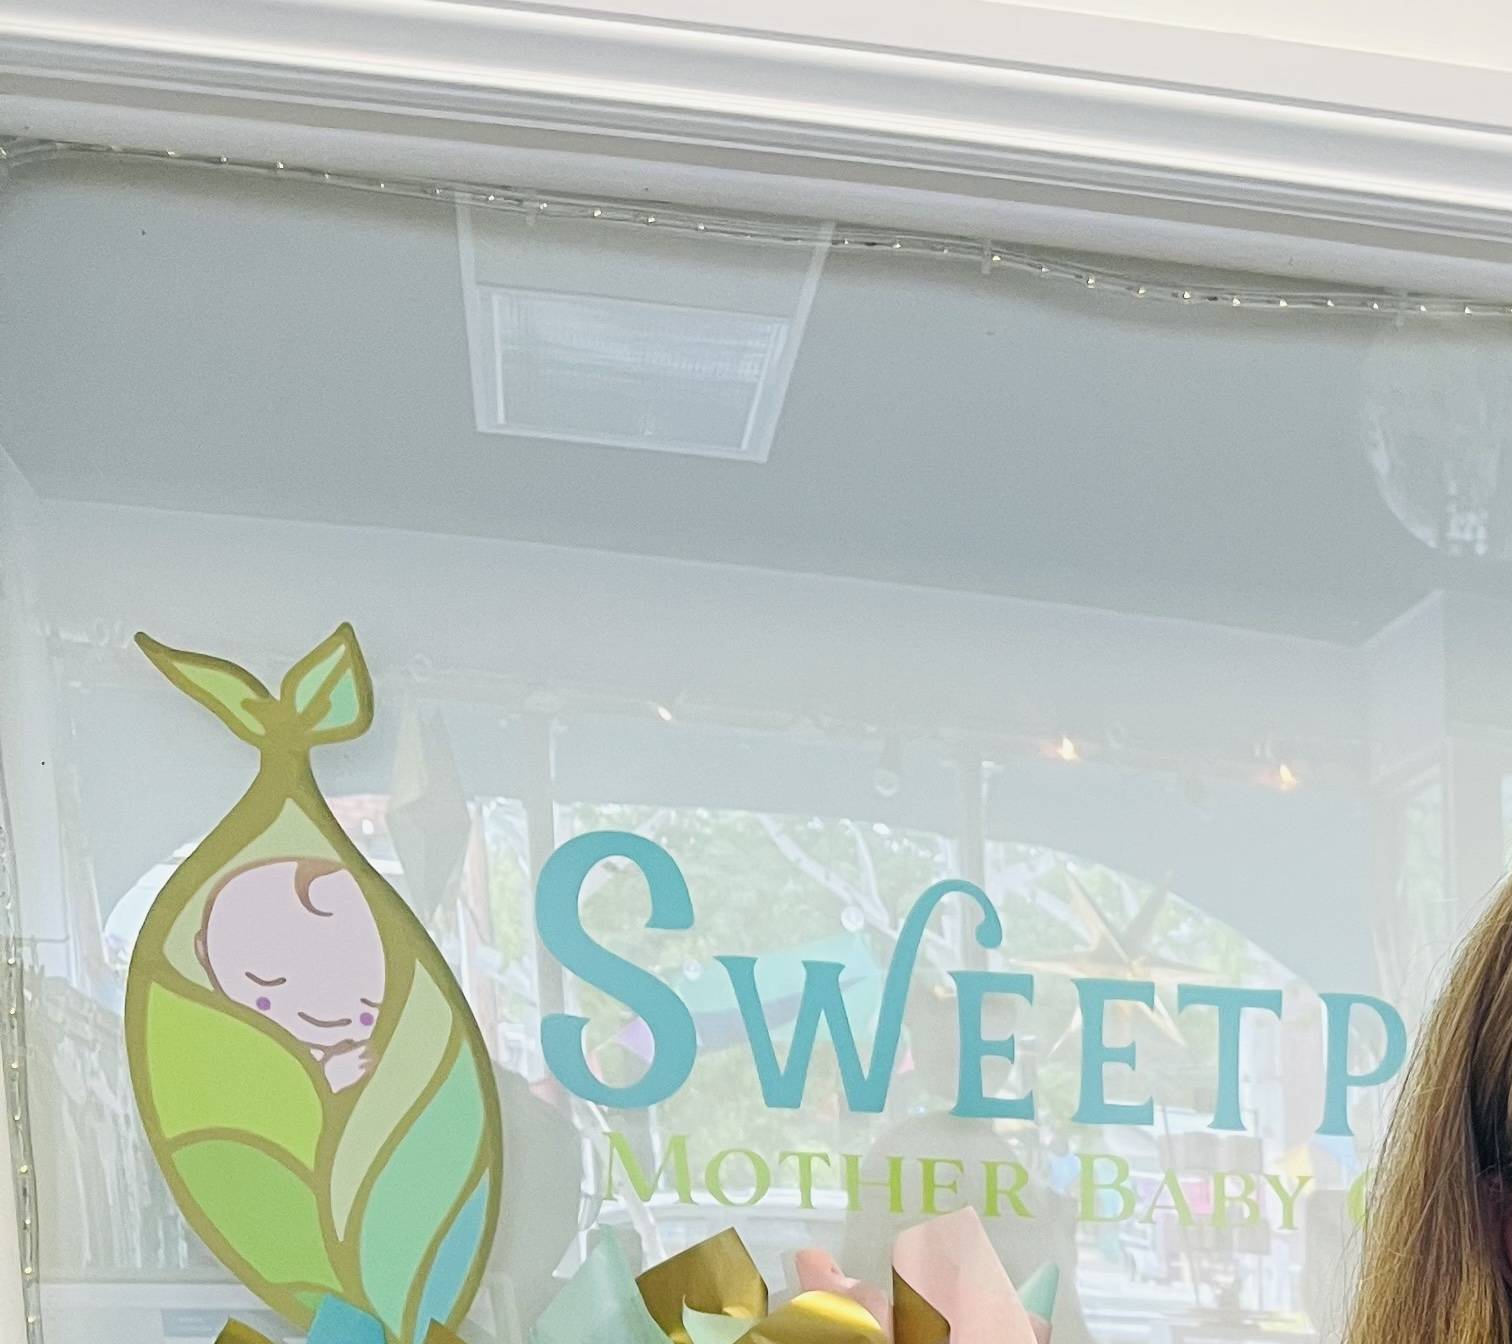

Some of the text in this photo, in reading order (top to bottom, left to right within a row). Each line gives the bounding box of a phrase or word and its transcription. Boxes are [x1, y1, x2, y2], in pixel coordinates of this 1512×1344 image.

[535, 830, 1409, 1137] SWEETP
[601, 1131, 1036, 1221] MOTHER
[1073, 1152, 1314, 1231] BABY
